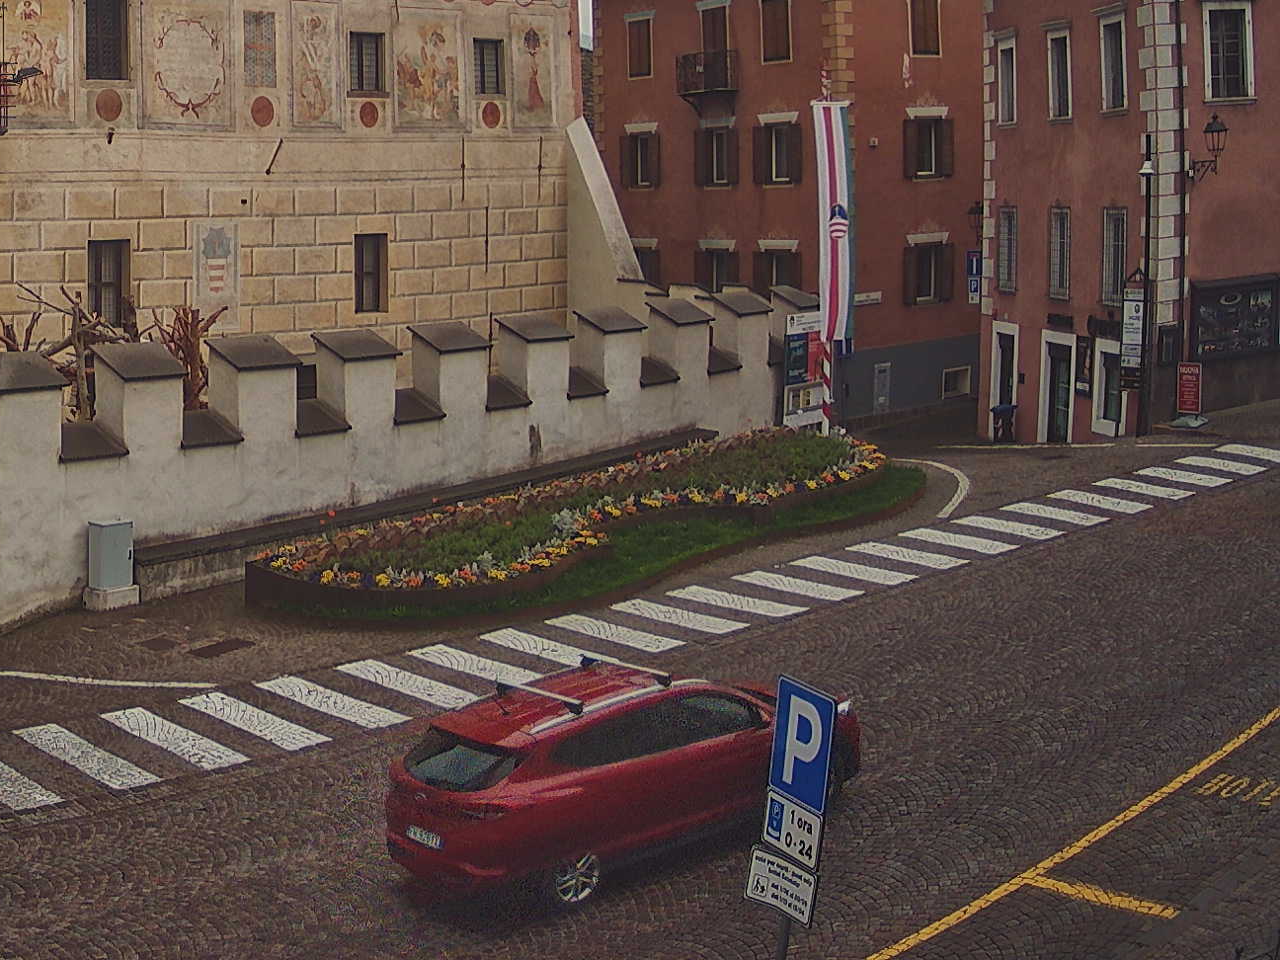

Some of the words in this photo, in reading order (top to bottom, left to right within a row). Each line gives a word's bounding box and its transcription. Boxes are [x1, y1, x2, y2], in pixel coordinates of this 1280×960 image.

[782, 694, 822, 785] P
[790, 810, 795, 825] 1
[797, 818, 813, 836] ora
